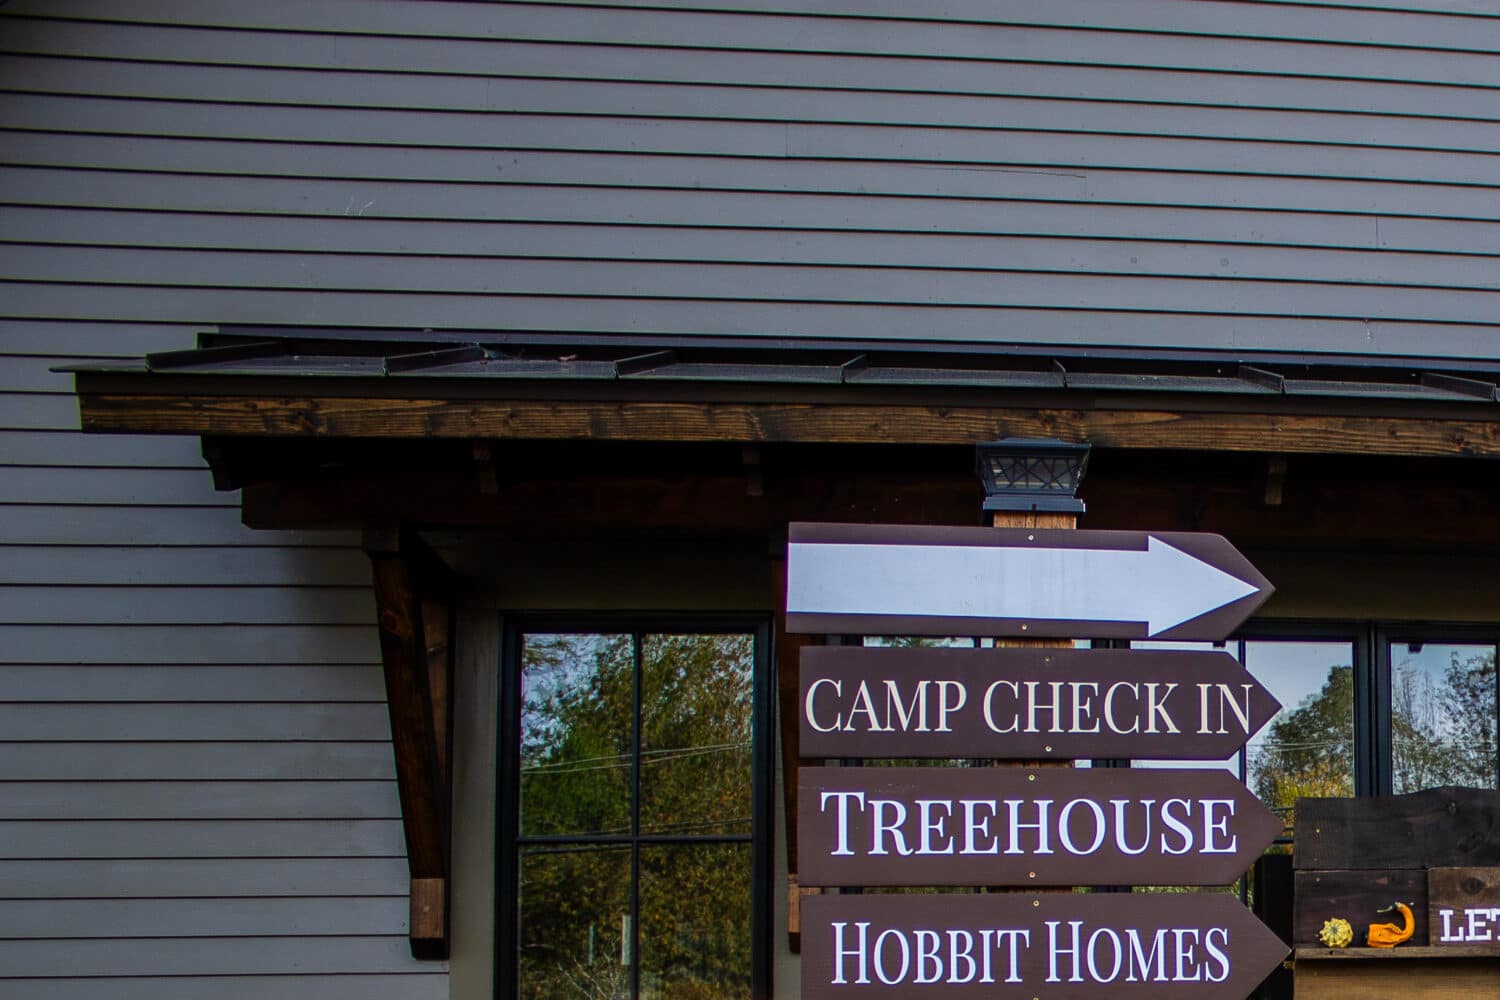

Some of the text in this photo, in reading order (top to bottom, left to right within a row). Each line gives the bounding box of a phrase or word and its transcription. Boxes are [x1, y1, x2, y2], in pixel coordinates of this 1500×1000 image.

[805, 678, 1253, 735] CAMP CHECK IN
[820, 791, 1237, 856] TREEHOUSE
[831, 920, 1230, 985] HOBBIT HOMES
